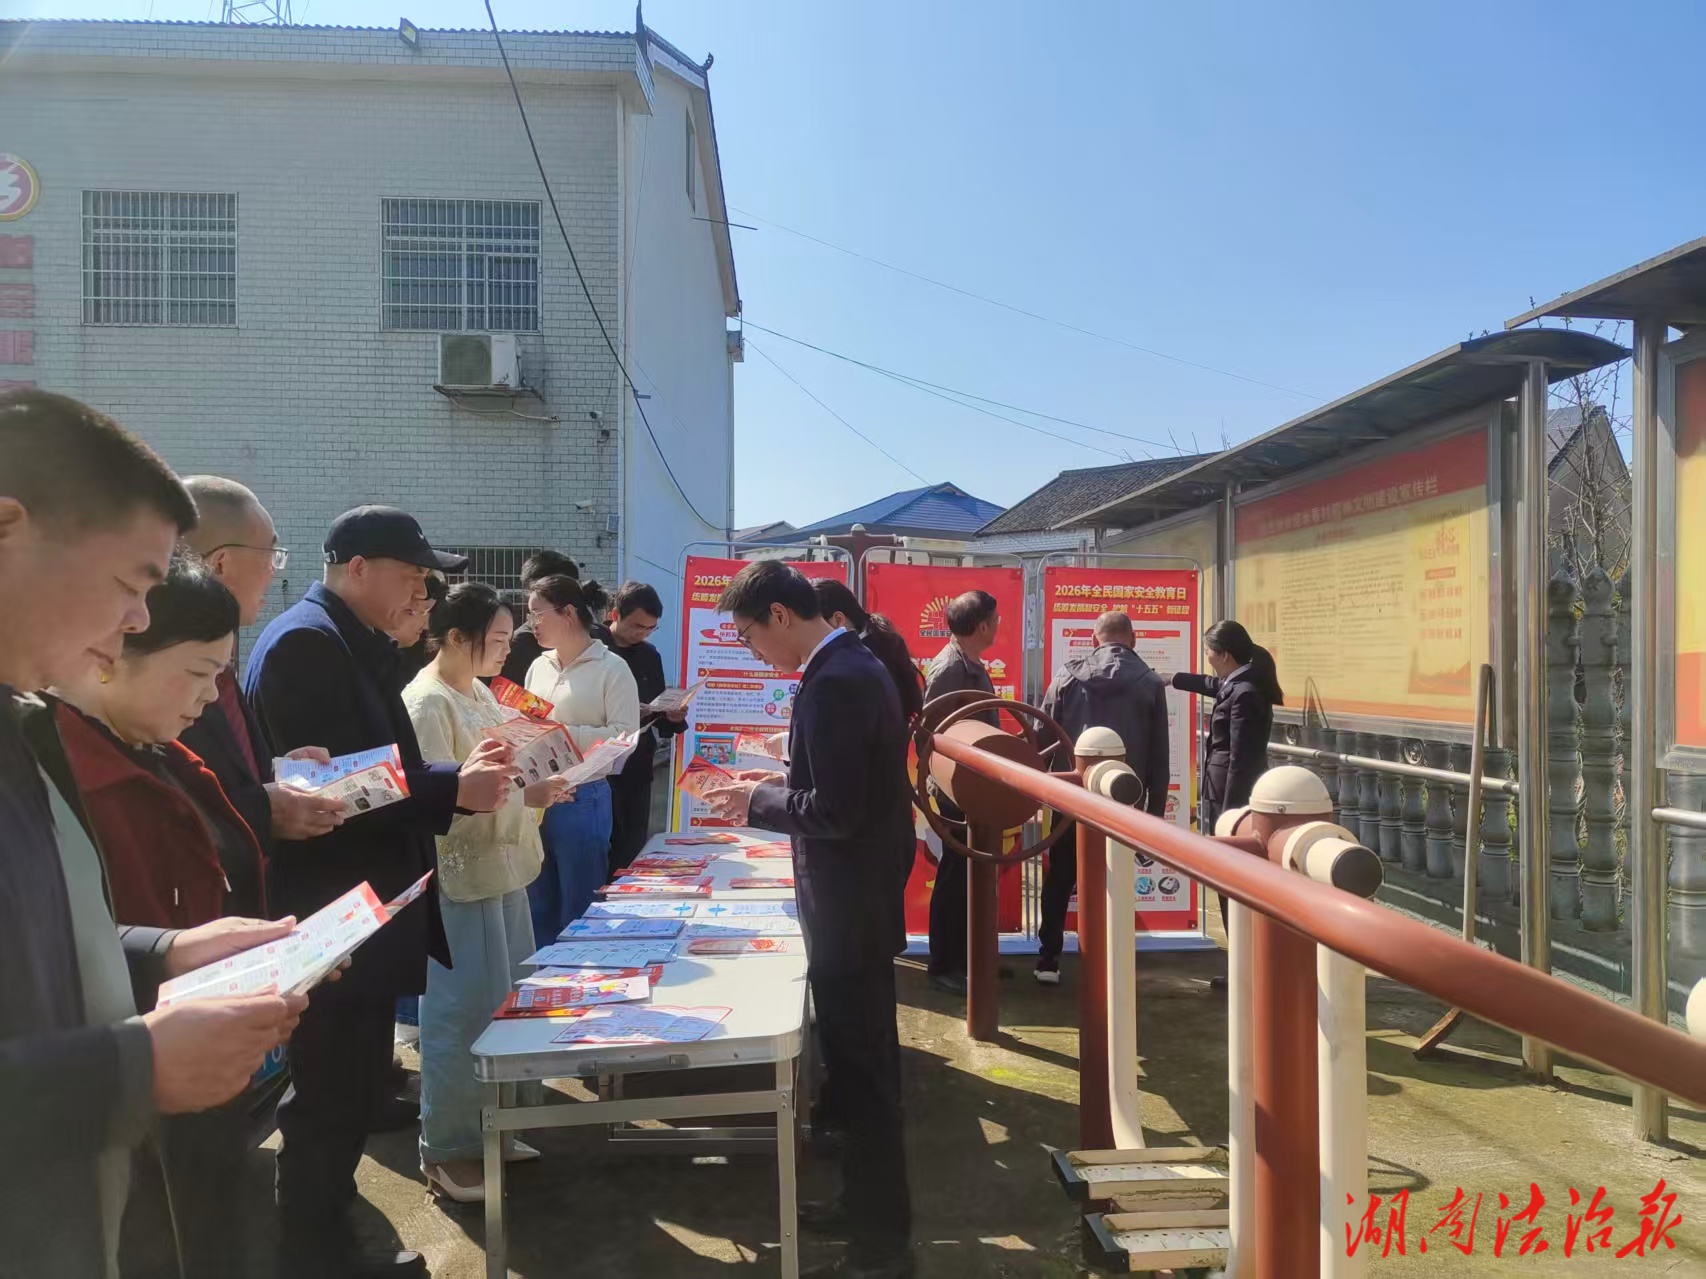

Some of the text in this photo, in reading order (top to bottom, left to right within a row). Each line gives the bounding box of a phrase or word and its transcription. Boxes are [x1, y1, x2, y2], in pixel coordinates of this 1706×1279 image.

[1054, 584, 1187, 602] 2026年全民国家安全教育日
